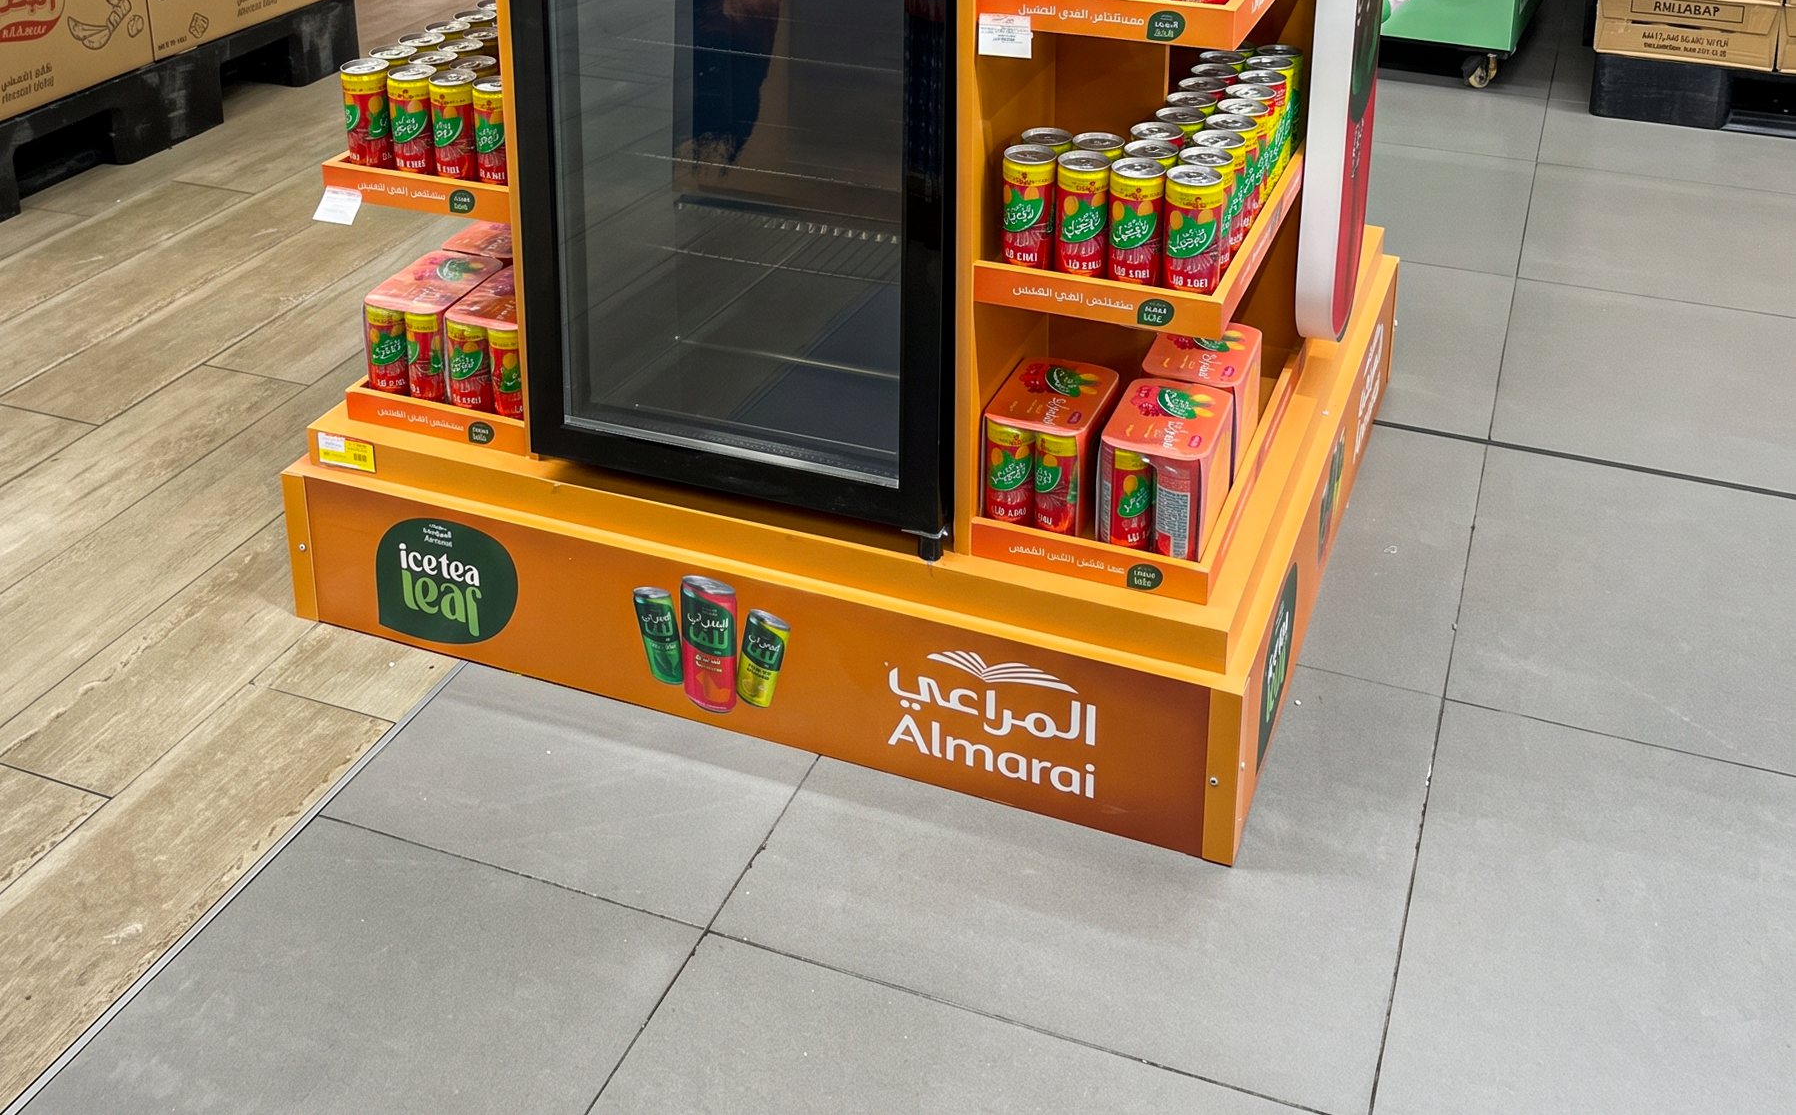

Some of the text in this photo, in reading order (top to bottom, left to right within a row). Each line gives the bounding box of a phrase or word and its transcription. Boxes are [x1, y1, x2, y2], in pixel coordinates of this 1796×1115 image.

[401, 569, 482, 637] leaf
[888, 666, 1097, 747] المراعي
[887, 713, 1096, 800] Almarai
